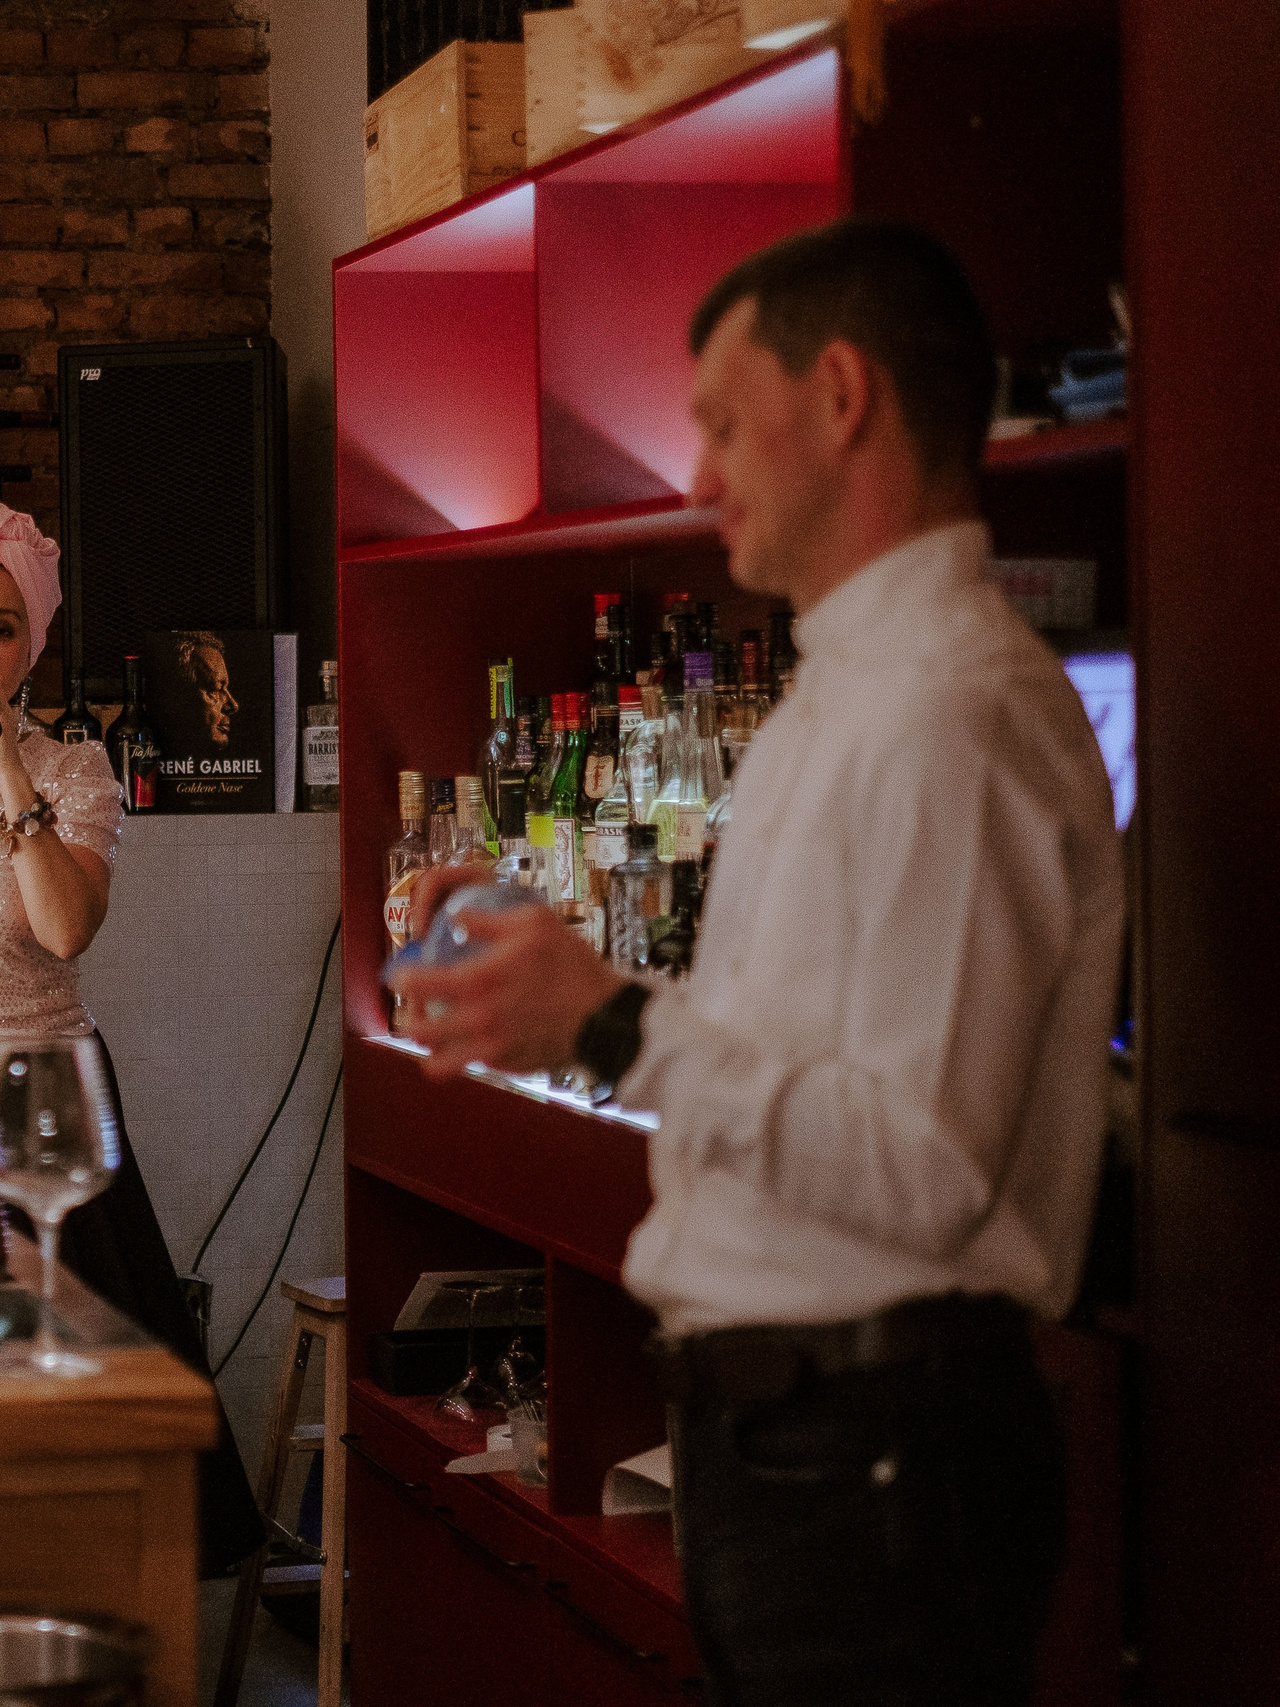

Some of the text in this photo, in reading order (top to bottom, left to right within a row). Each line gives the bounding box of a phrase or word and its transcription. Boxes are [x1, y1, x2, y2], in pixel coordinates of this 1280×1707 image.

[158, 757, 262, 774] RENÉ GABRIEL
[176, 782, 243, 794] Goldene Nase
[388, 906, 404, 922] AV
